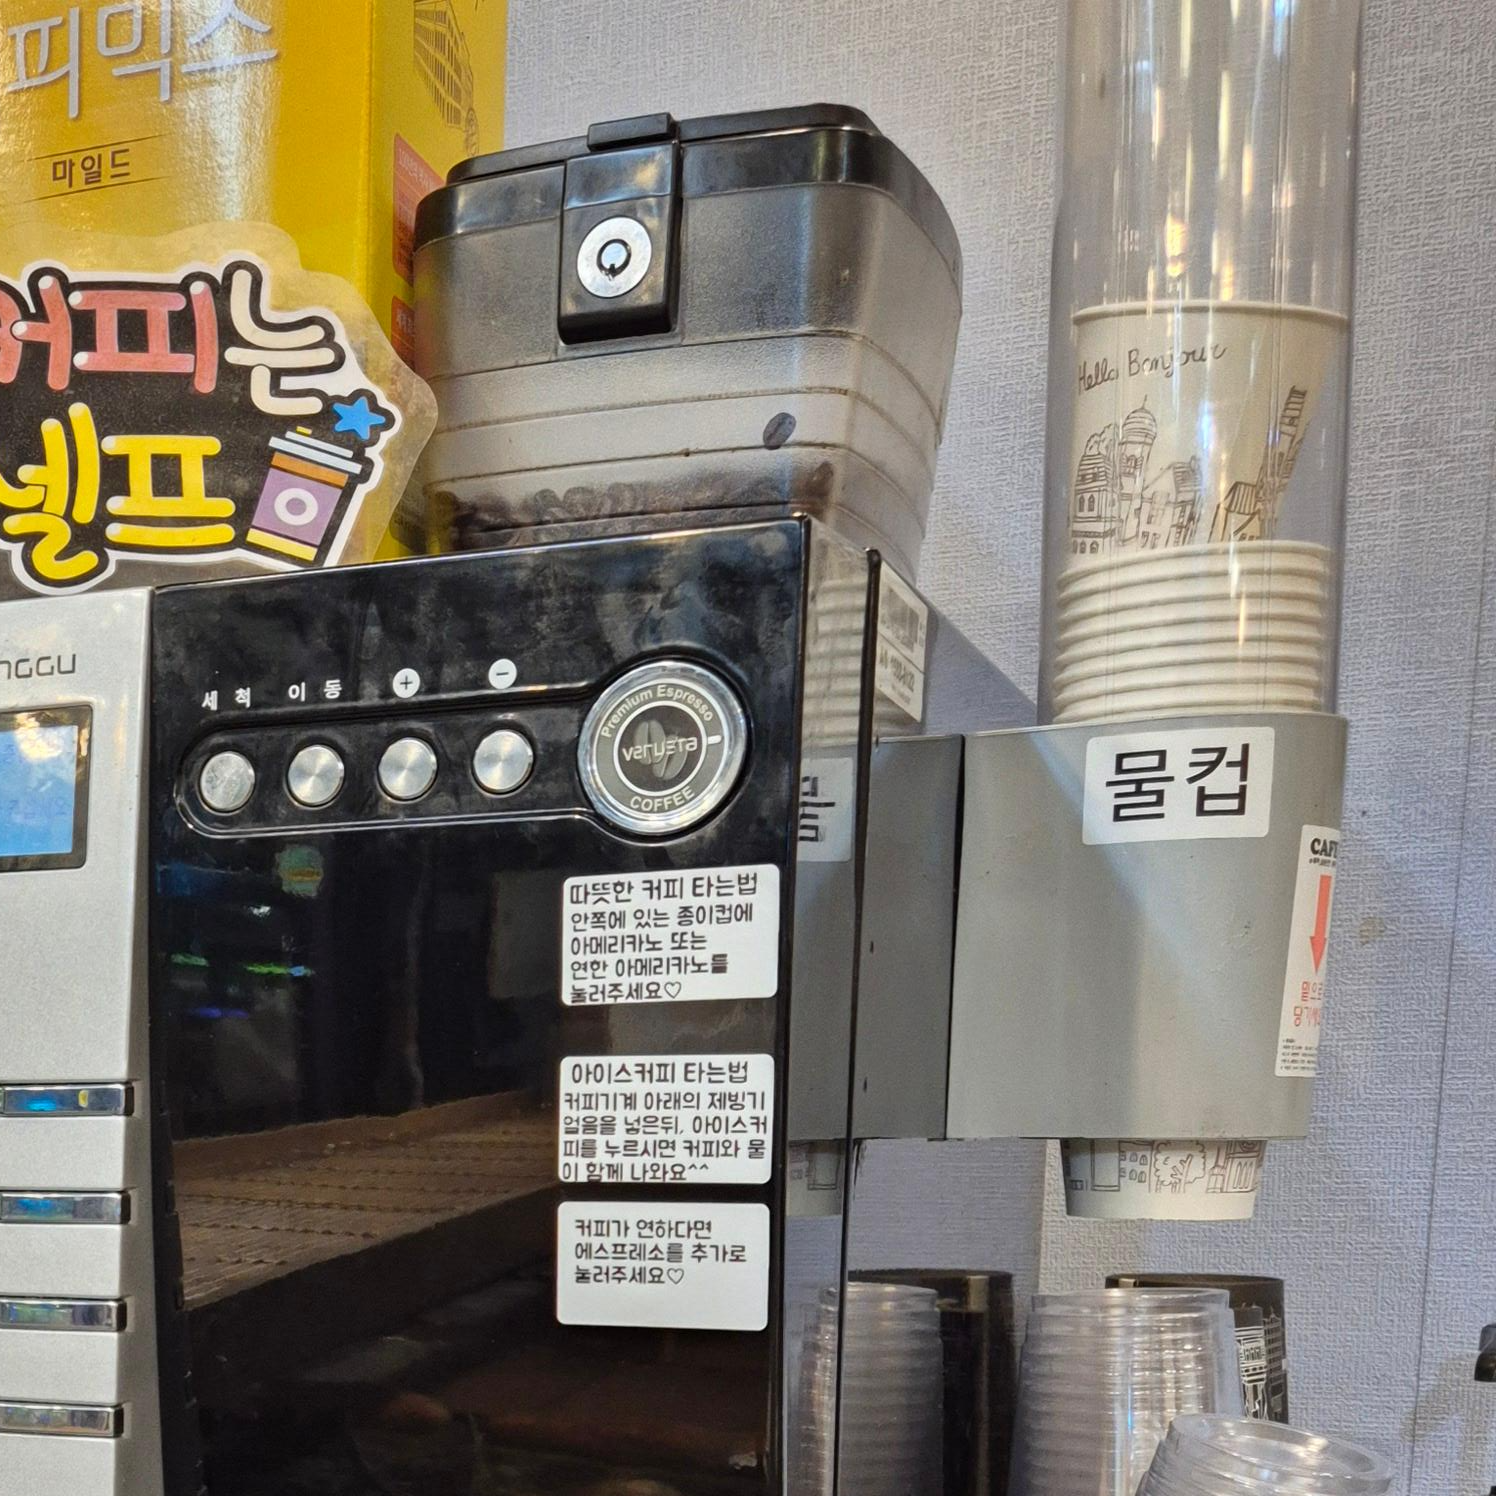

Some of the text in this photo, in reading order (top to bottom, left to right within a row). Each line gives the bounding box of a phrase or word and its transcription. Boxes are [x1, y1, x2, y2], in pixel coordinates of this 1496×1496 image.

[52, 147, 131, 187] 마일드
[1078, 358, 1119, 395] Hello
[601, 684, 714, 738] Premium Espresso
[1105, 743, 1250, 823] 물컵
[630, 785, 696, 812] COFFEE
[570, 872, 759, 905] 따뜻한 커피 타는법
[570, 902, 754, 932] 안쪽에 있는 종이컵에
[570, 931, 708, 956] 아메리카노 또는
[570, 960, 609, 981] 연한
[571, 1060, 749, 1085] 아이스커피 타는법
[563, 1091, 766, 1112] 커피기계 아래의 제빙기
[563, 1115, 617, 1135] 얼음을
[692, 1114, 768, 1135] 아이스커
[563, 1138, 767, 1160] 피를 누르시면 커피와 물
[562, 1162, 579, 1182] 이
[586, 1161, 624, 1183] 함께
[574, 1218, 713, 1240] 커피가 연하다면
[574, 1242, 748, 1264] 에스프레소를 추가로
